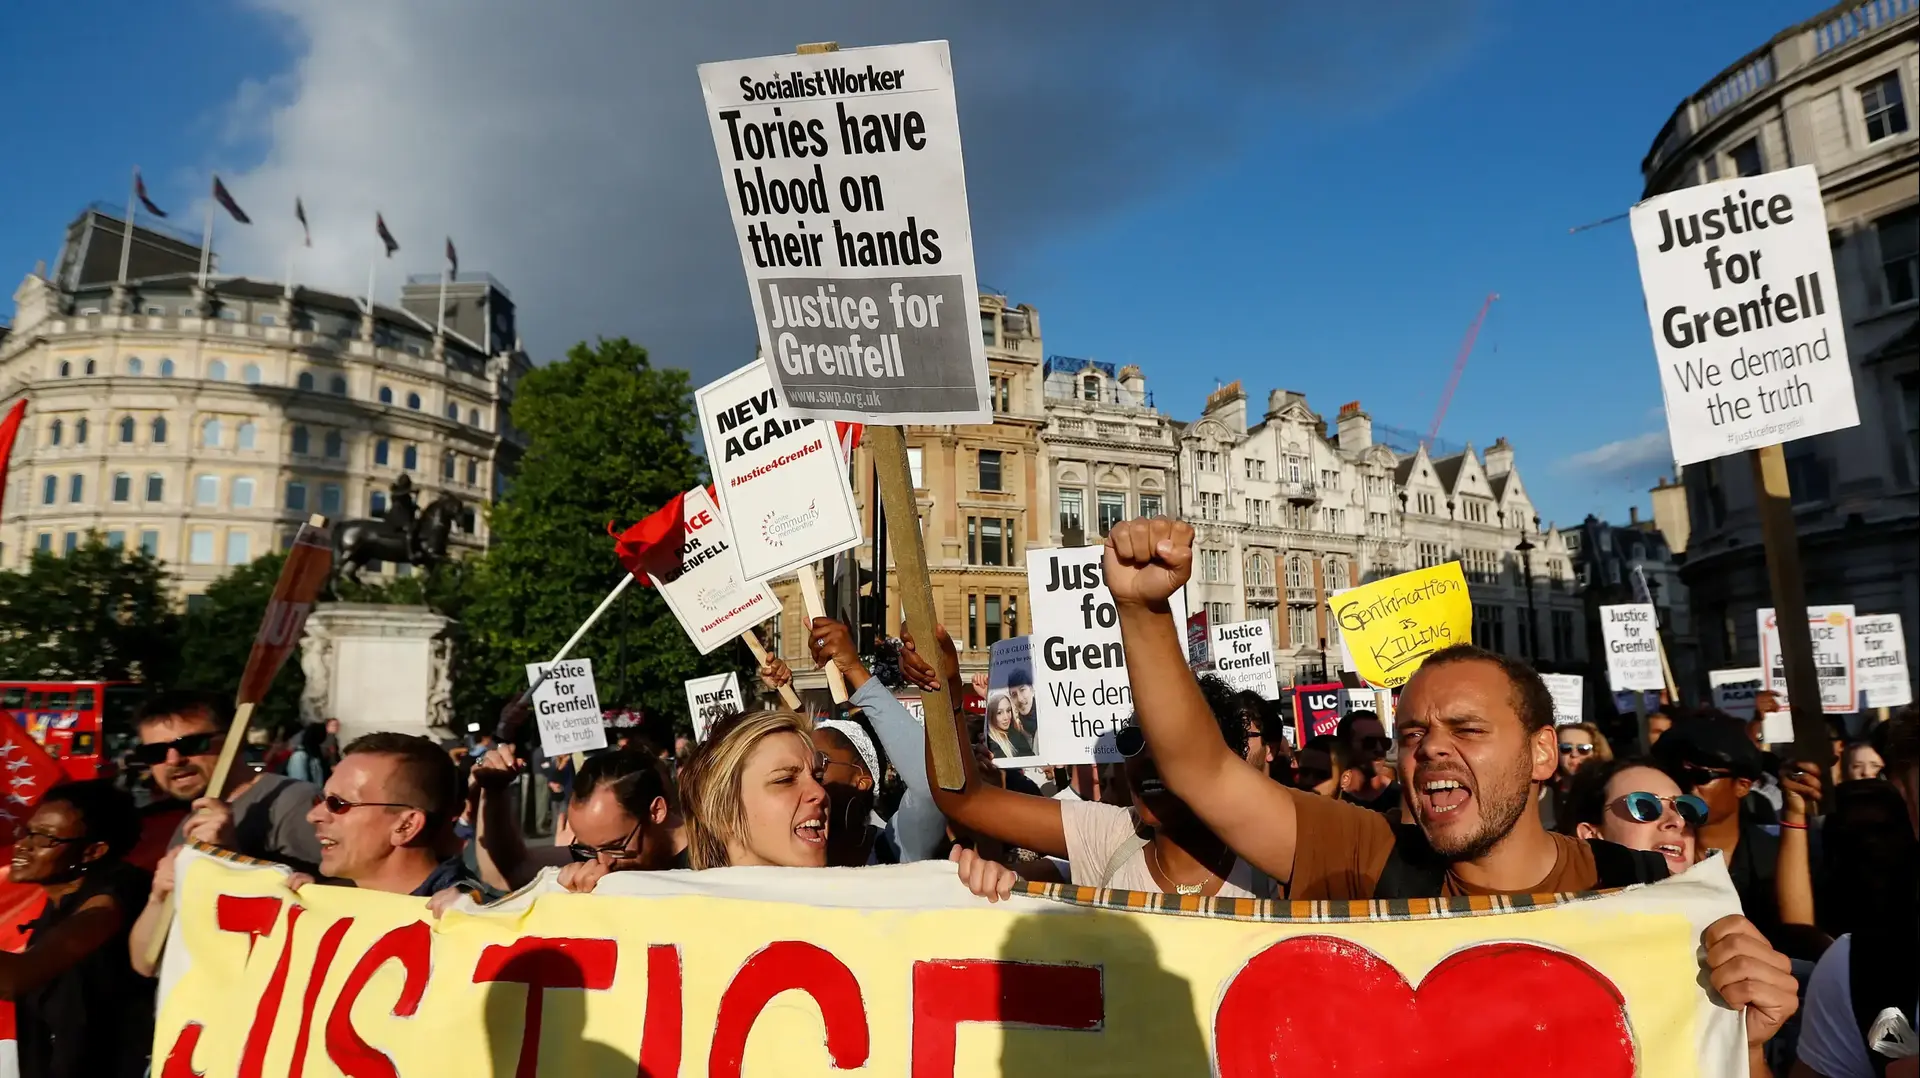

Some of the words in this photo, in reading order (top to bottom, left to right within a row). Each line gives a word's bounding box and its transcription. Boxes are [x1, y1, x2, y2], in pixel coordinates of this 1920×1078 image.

[719, 107, 828, 161] Tories
[836, 101, 927, 155] have
[734, 164, 830, 216] blood
[840, 174, 884, 212] on
[1658, 189, 1794, 253] Justice
[748, 220, 823, 269] their
[835, 216, 942, 267] hands
[1703, 245, 1762, 290] for
[768, 283, 879, 329] Justice
[888, 282, 943, 328] for
[1662, 271, 1826, 349] Grenfell
[777, 332, 905, 378] Grenfell
[1673, 357, 1722, 394] We
[1730, 328, 1832, 382] demand
[716, 387, 778, 435] NEV
[788, 389, 881, 409] www.swp.org.uk
[1706, 393, 1752, 427] the
[1757, 374, 1814, 415] truth
[730, 439, 823, 488] #Justice4Grenfell
[684, 509, 713, 535] ICE
[768, 507, 820, 535] Community
[777, 520, 814, 539] membership
[700, 593, 764, 633] #Justice4Grenfell
[1337, 578, 1461, 632] Gentrification
[1608, 608, 1649, 623] Justice
[1218, 624, 1263, 642] Justice
[1623, 623, 1641, 638] for
[1043, 635, 1124, 672] Gren
[1232, 640, 1252, 655] for
[1370, 621, 1452, 670] KILLING
[1611, 638, 1656, 654] Grenfell
[1775, 652, 1842, 666] GFELL
[538, 663, 585, 681] Justice
[1218, 651, 1271, 671] Grenfell
[554, 680, 575, 696] for
[1238, 669, 1272, 684] demand
[539, 694, 597, 716] Grenfell
[695, 689, 735, 706] NEVER
[1048, 680, 1086, 708] We
[542, 718, 562, 731] We
[563, 712, 599, 730] demand
[1071, 711, 1105, 738] the
[554, 731, 571, 744] the
[572, 727, 594, 743] truth
